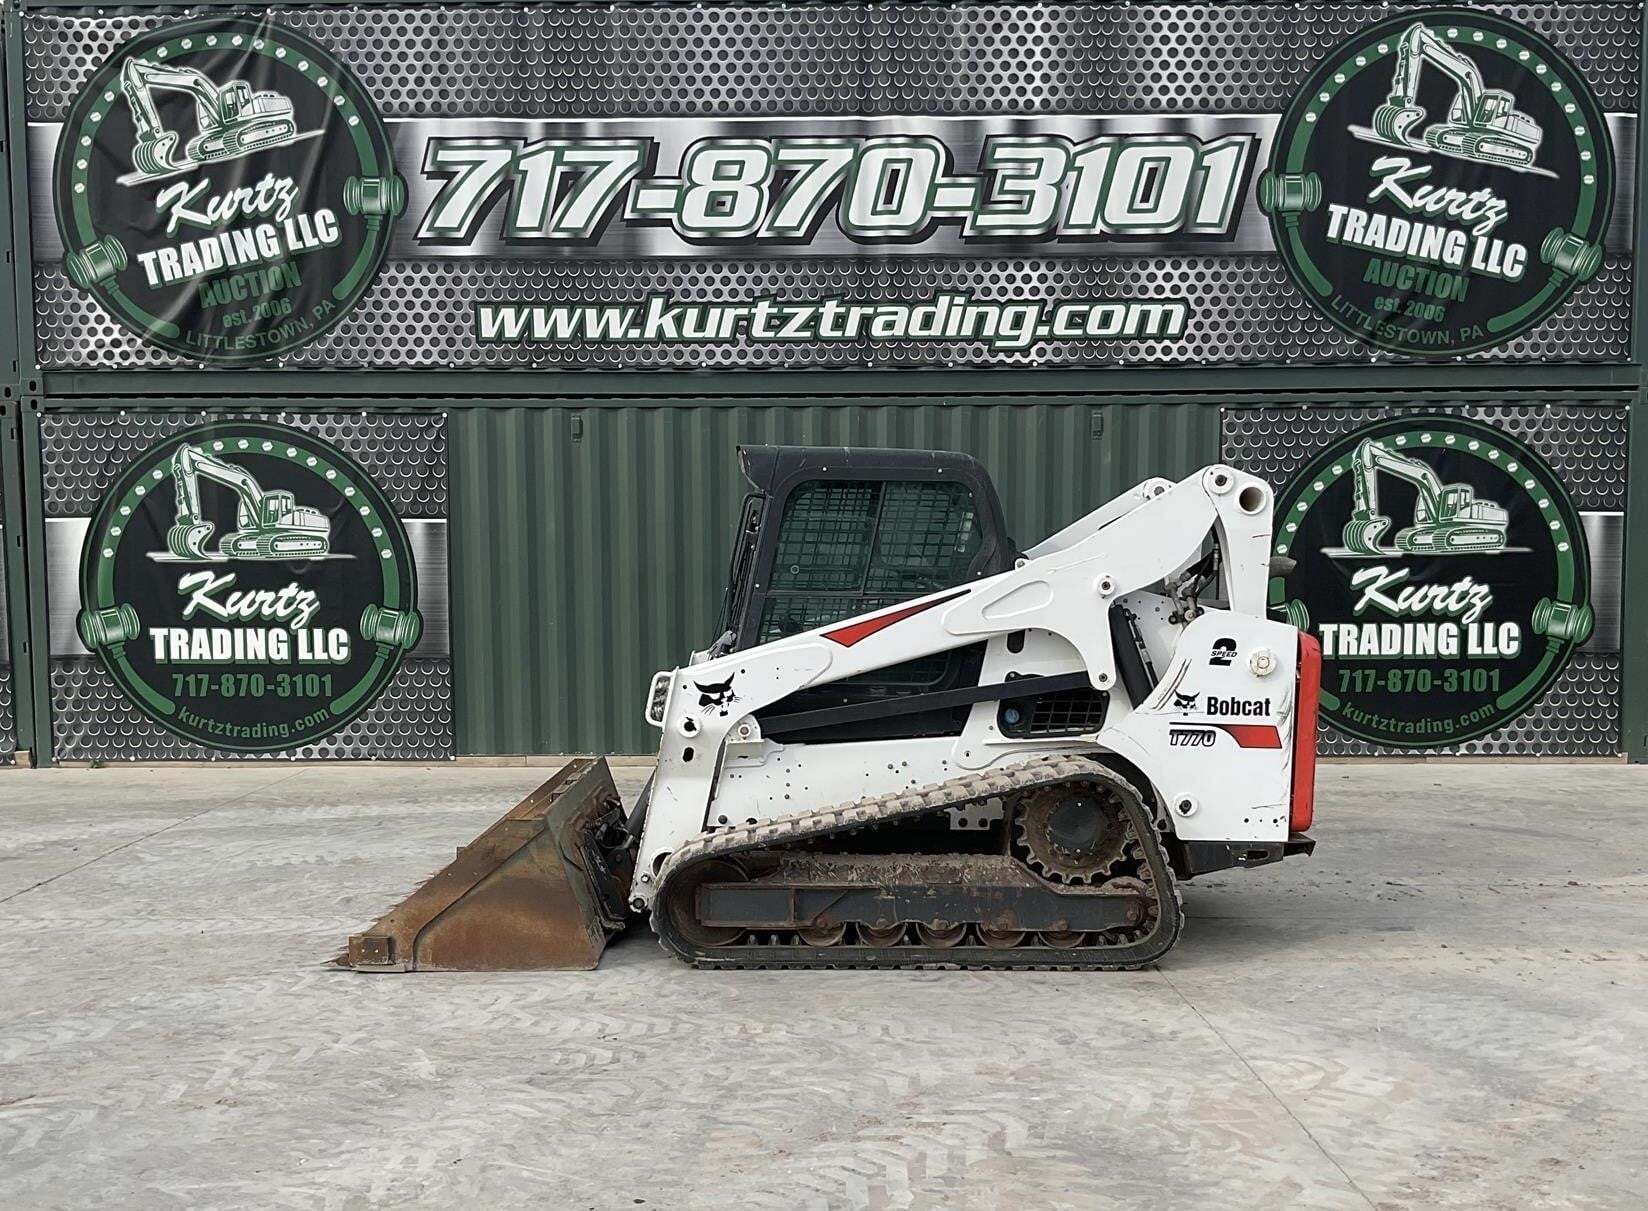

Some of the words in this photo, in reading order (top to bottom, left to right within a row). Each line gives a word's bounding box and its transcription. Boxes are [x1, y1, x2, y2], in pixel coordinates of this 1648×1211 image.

[156, 172, 299, 236] Kurtz
[417, 137, 1256, 243] 717-870-3101
[1367, 155, 1508, 236] Kurtz
[137, 219, 281, 285] TRADING
[284, 209, 340, 251] LLC
[1327, 204, 1467, 265] TRADING
[1471, 235, 1528, 279] LLC
[199, 261, 303, 310] AUCTION
[1363, 258, 1470, 302] AUCTION
[185, 314, 314, 351] LITTLESTOWN,
[313, 301, 337, 321] PA
[222, 307, 251, 329] est.
[252, 298, 293, 325] 2006
[478, 294, 1188, 349] www.kurtztrading.com
[1331, 294, 1455, 346] LITTLESTOWN,
[1460, 325, 1484, 341] PA
[1374, 297, 1401, 314] est.
[1405, 299, 1445, 323] 2006
[177, 570, 320, 629] Kurtz
[1351, 565, 1493, 624] Kurtz
[149, 628, 289, 661] TRADING
[297, 627, 350, 661] LLC
[1209, 637, 1237, 666] 2
[1210, 650, 1238, 658] SPEED
[1319, 623, 1459, 656] TRADING
[1467, 622, 1520, 656] LLC
[172, 673, 332, 697] 717-870-3101
[1339, 668, 1500, 693] 717-870-3101
[178, 705, 330, 739] kurtztrading.com
[1207, 697, 1271, 716] Bobcat
[1342, 701, 1495, 735] kurtztrading.com
[1169, 729, 1216, 747] T770
